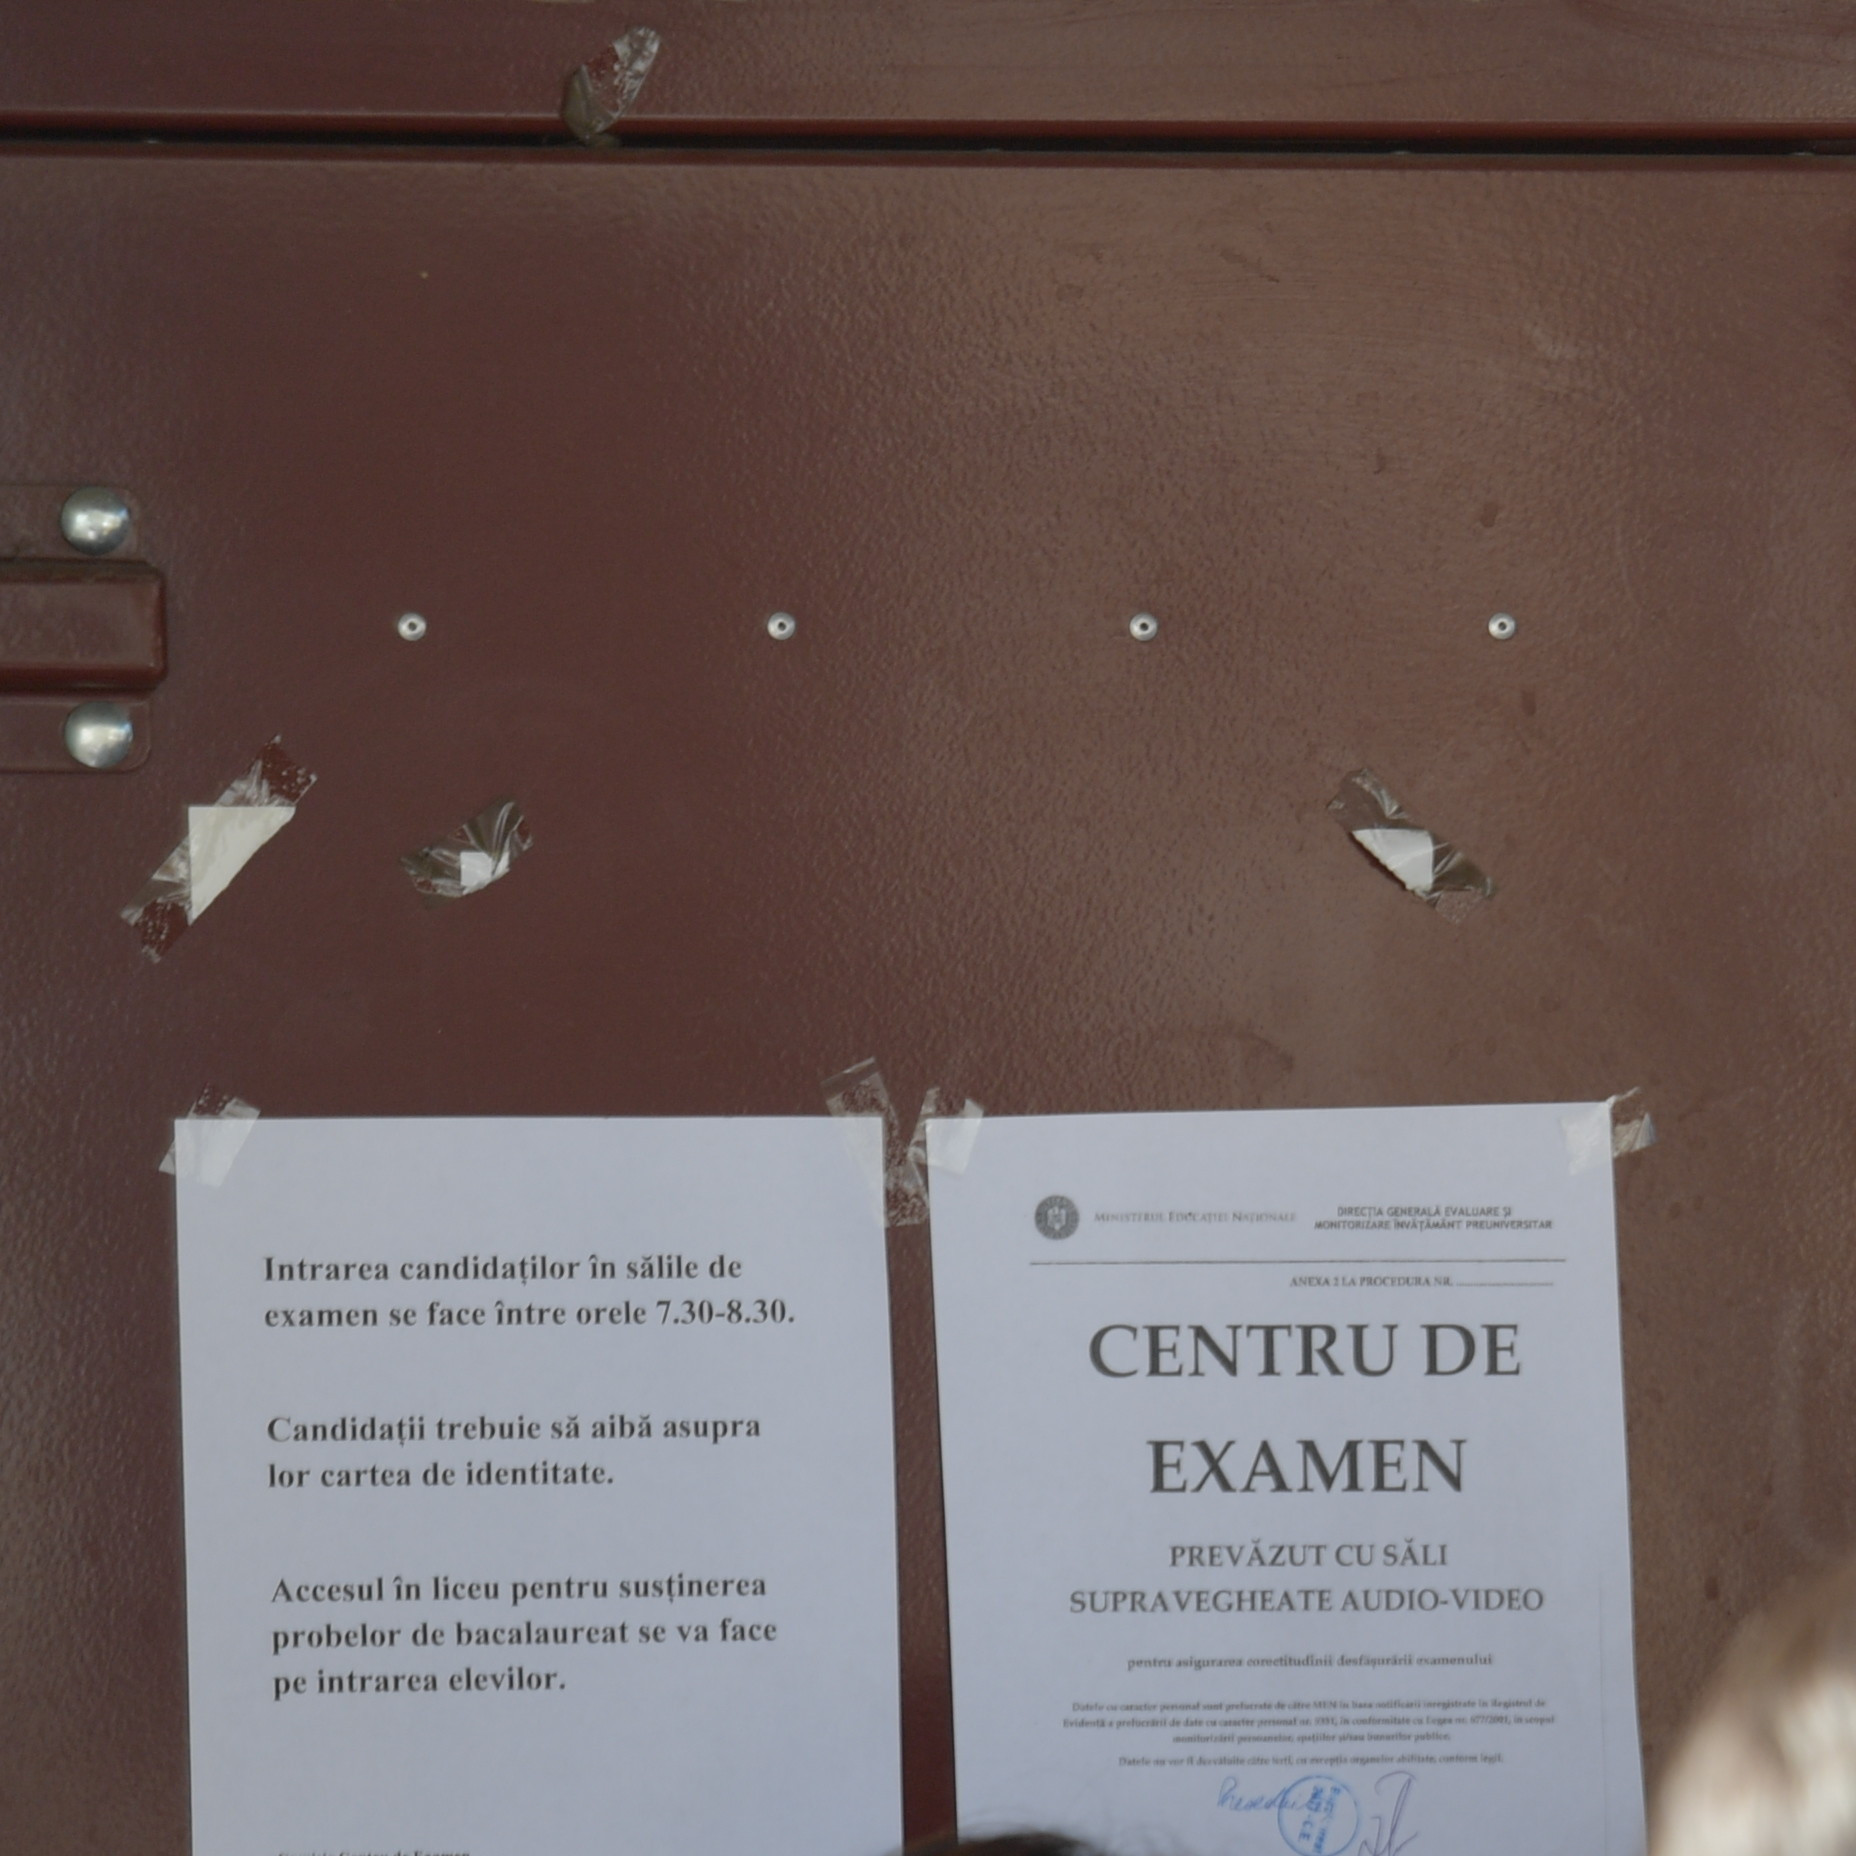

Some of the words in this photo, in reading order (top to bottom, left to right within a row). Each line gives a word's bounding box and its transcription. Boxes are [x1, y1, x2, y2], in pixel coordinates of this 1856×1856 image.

[1314, 1220, 1390, 1231] MONITORIZARE
[1466, 1219, 1552, 1230] PREUNIVERSITAR
[1337, 1206, 1383, 1219] DIRECȚIA
[1386, 1204, 1441, 1217] GENERALĂ
[1445, 1206, 1500, 1217] EVALUARE
[264, 1257, 389, 1282] Intrarea
[400, 1255, 580, 1285] candidaților
[590, 1254, 617, 1280] în
[626, 1254, 699, 1279] sălile
[709, 1254, 742, 1279] de
[1290, 1276, 1331, 1288] ANEXA
[1333, 1276, 1339, 1287] 2
[1341, 1276, 1356, 1287] LA
[1359, 1275, 1430, 1288] PROCEDURA
[264, 1306, 378, 1328] examen
[389, 1306, 417, 1327] se
[427, 1301, 486, 1327] face
[495, 1300, 567, 1326] între
[576, 1300, 647, 1325] orele
[655, 1299, 796, 1325] 7.30-8.30.
[1089, 1323, 1398, 1378] CENTRU
[1420, 1323, 1521, 1376] DE
[267, 1416, 427, 1447] Candidații
[436, 1415, 541, 1441] trebuie
[551, 1415, 580, 1440] să
[592, 1415, 653, 1439] aibă
[663, 1417, 761, 1444] asupra
[268, 1462, 311, 1487] lor
[321, 1465, 411, 1487] cartea
[422, 1462, 456, 1486] de
[466, 1461, 615, 1486] identitate.
[1146, 1438, 1467, 1494] EXAMEN
[1168, 1539, 1327, 1568] PREVĂZUT
[1334, 1544, 1376, 1568] CU
[1382, 1537, 1448, 1567] SĂLI
[271, 1578, 384, 1602] Accesul
[394, 1576, 422, 1601] în
[433, 1576, 500, 1601] liceu
[511, 1580, 608, 1605] pentru
[618, 1573, 766, 1603] susținerea
[1068, 1589, 1333, 1614] SUPRAVEGHEATE
[1340, 1587, 1545, 1612] AUDIO-VIDEO
[272, 1622, 402, 1655] probelor
[411, 1622, 446, 1646] de
[455, 1620, 630, 1646] bacalaureat
[638, 1624, 667, 1644] se
[677, 1625, 709, 1643] va
[719, 1617, 778, 1642] face
[1127, 1657, 1172, 1672] pentru
[1175, 1656, 1243, 1671] asigurarea
[1246, 1654, 1333, 1668] corectitudinii
[1337, 1653, 1413, 1669] desfășurării
[1416, 1653, 1493, 1666] examenului
[273, 1674, 307, 1700] pe
[317, 1668, 439, 1694] intrarea
[448, 1666, 567, 1691] elevilor.
